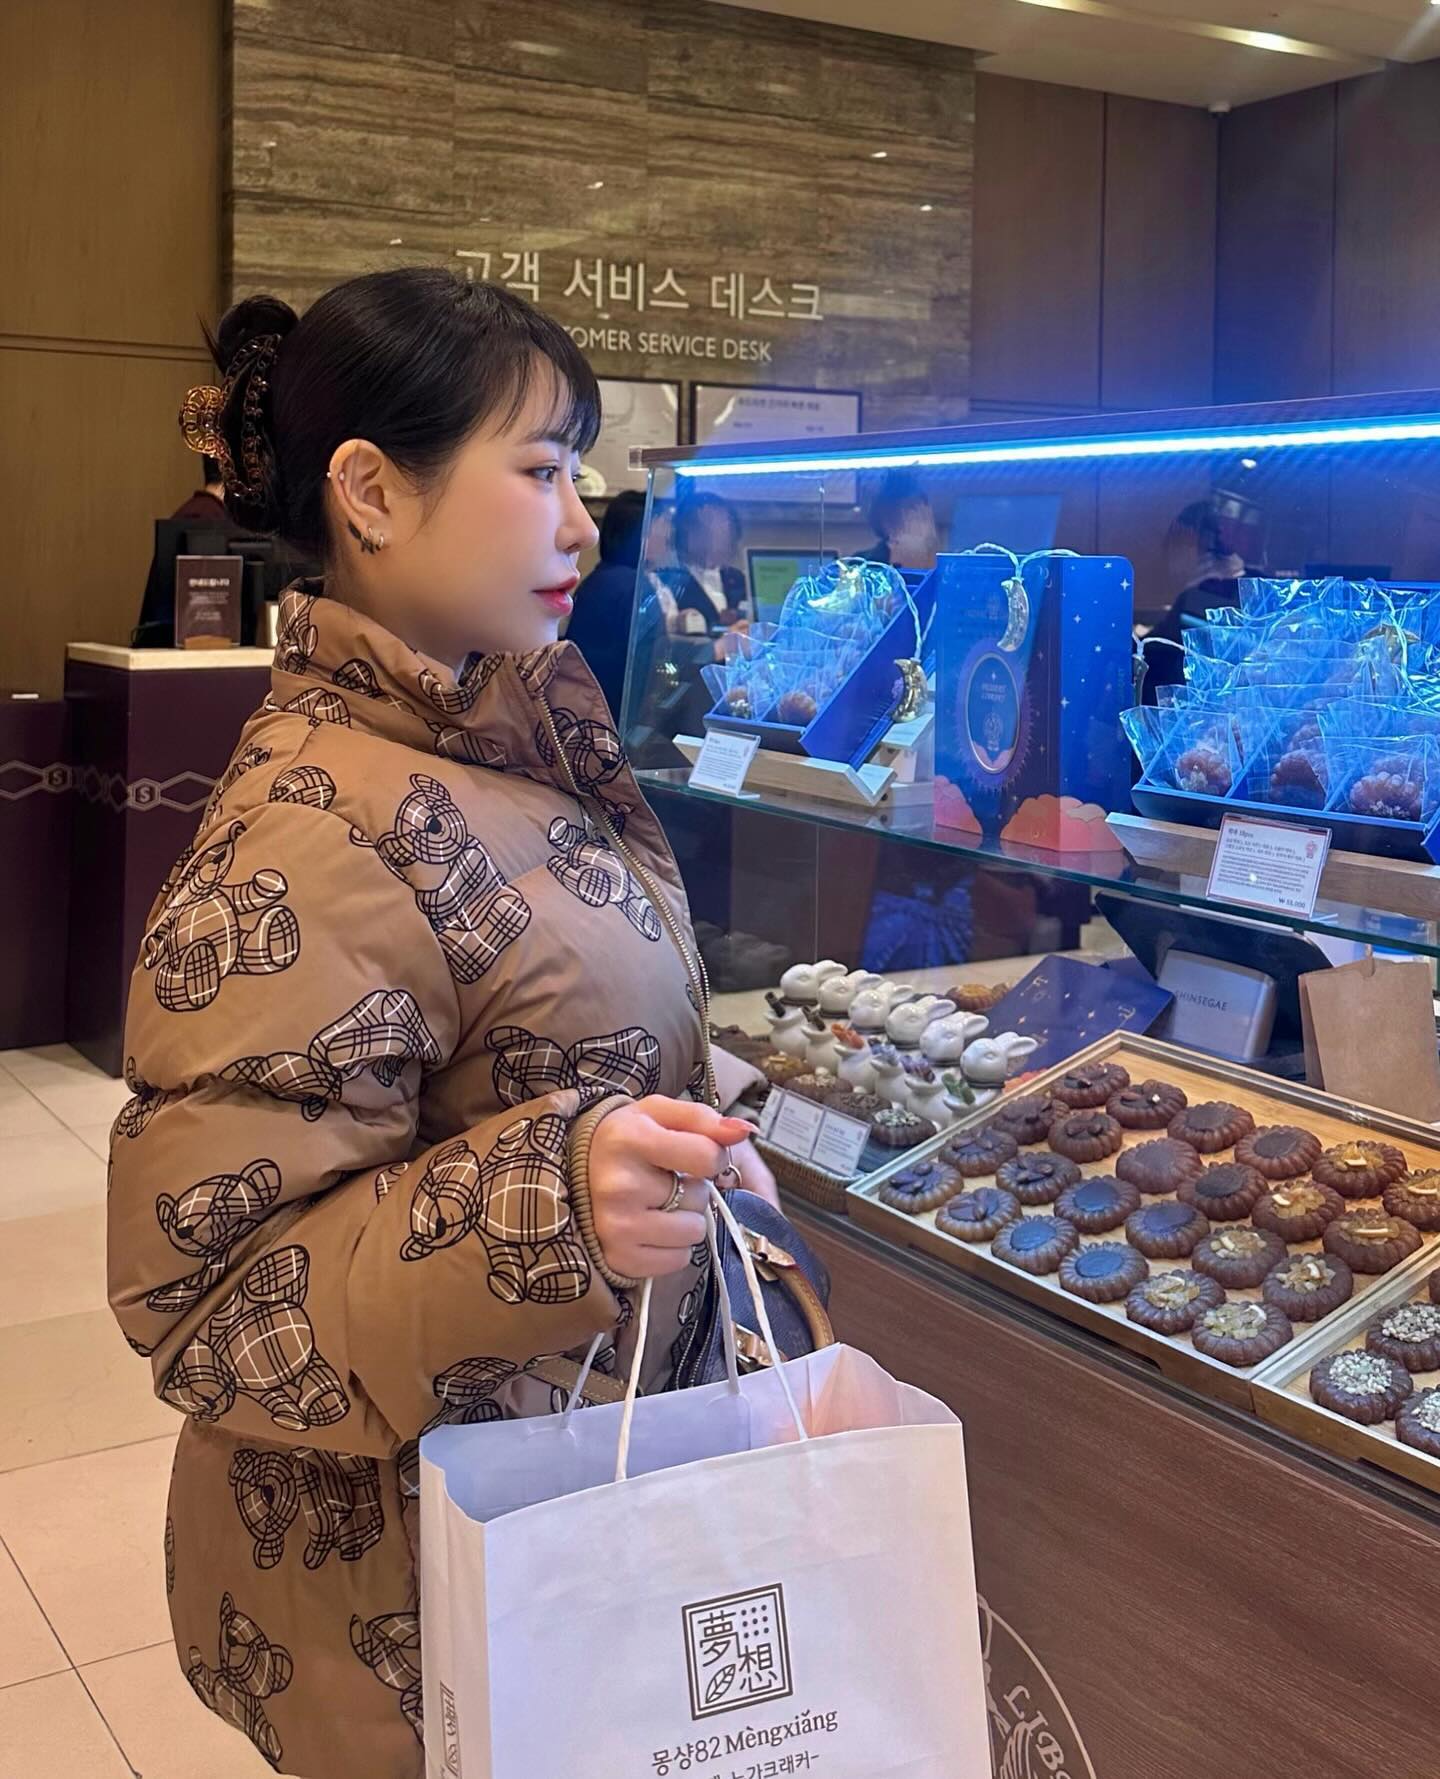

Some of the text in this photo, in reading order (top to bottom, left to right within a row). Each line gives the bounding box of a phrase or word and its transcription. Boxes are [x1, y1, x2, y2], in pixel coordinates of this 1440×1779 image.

[456, 249, 824, 321] 고객 서비스 데스크
[638, 331, 717, 358] SERVICE
[722, 338, 773, 362] DESK
[651, 1736, 723, 1777] 몽샹82
